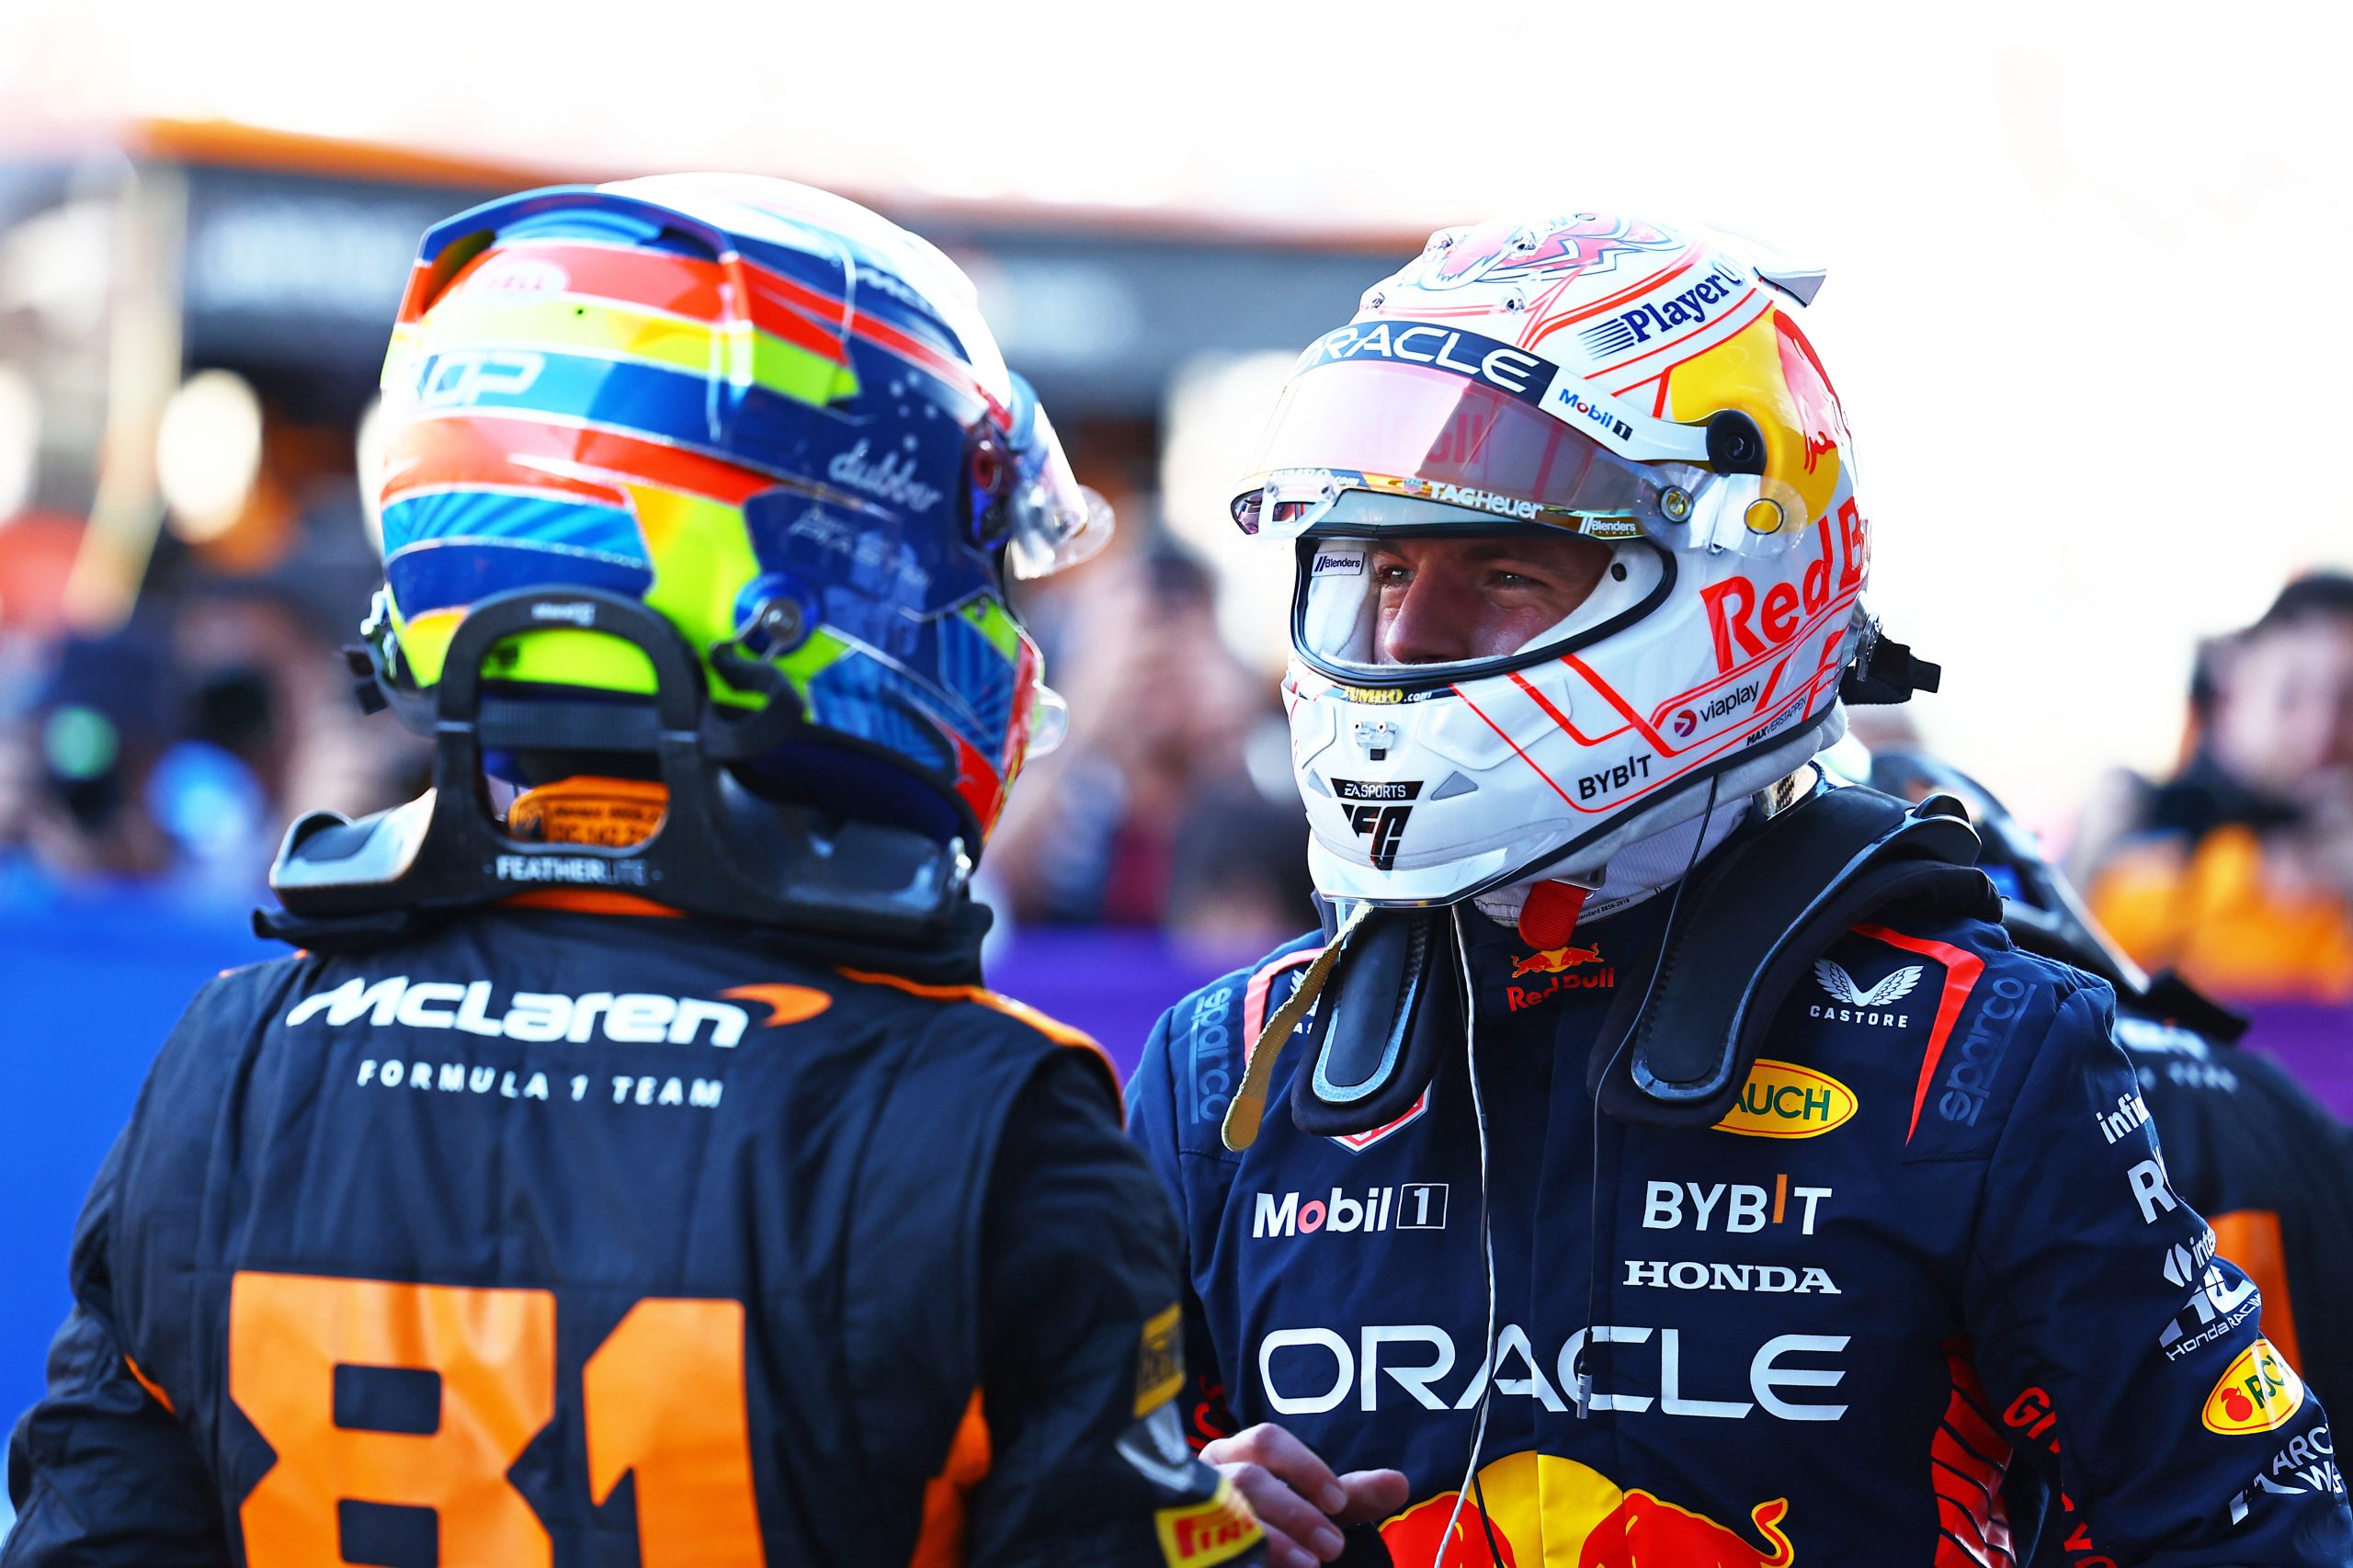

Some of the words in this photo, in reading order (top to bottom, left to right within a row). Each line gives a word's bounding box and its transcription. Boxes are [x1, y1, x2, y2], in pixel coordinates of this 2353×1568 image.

[1294, 324, 1540, 392] ORACLE
[1559, 388, 1614, 428] Mobil
[1592, 520, 1636, 531] Blenders
[1324, 557, 1361, 568] Blenders
[1699, 515, 1834, 675] Red
[1699, 680, 1759, 723] viaplay
[1578, 754, 1652, 801] BYBIT
[285, 974, 749, 1049] McLaren
[1506, 976, 1560, 1013] Red
[1563, 967, 1616, 990] Bull
[1810, 1005, 1909, 1028] CASTORE
[357, 1059, 550, 1101] FORMULA
[571, 1074, 589, 1102] 1
[612, 1075, 724, 1108] TEAM
[1253, 1187, 1393, 1239] Mobil
[1642, 1173, 1833, 1236] BYBIT
[1622, 1260, 1842, 1295] HONDA
[2165, 1322, 2230, 1361] Honda
[2226, 1291, 2261, 1329] RACIN
[1258, 1324, 1852, 1422] ORACLE
[229, 1269, 766, 1568] 81
[2272, 1423, 2334, 1475] ARC
